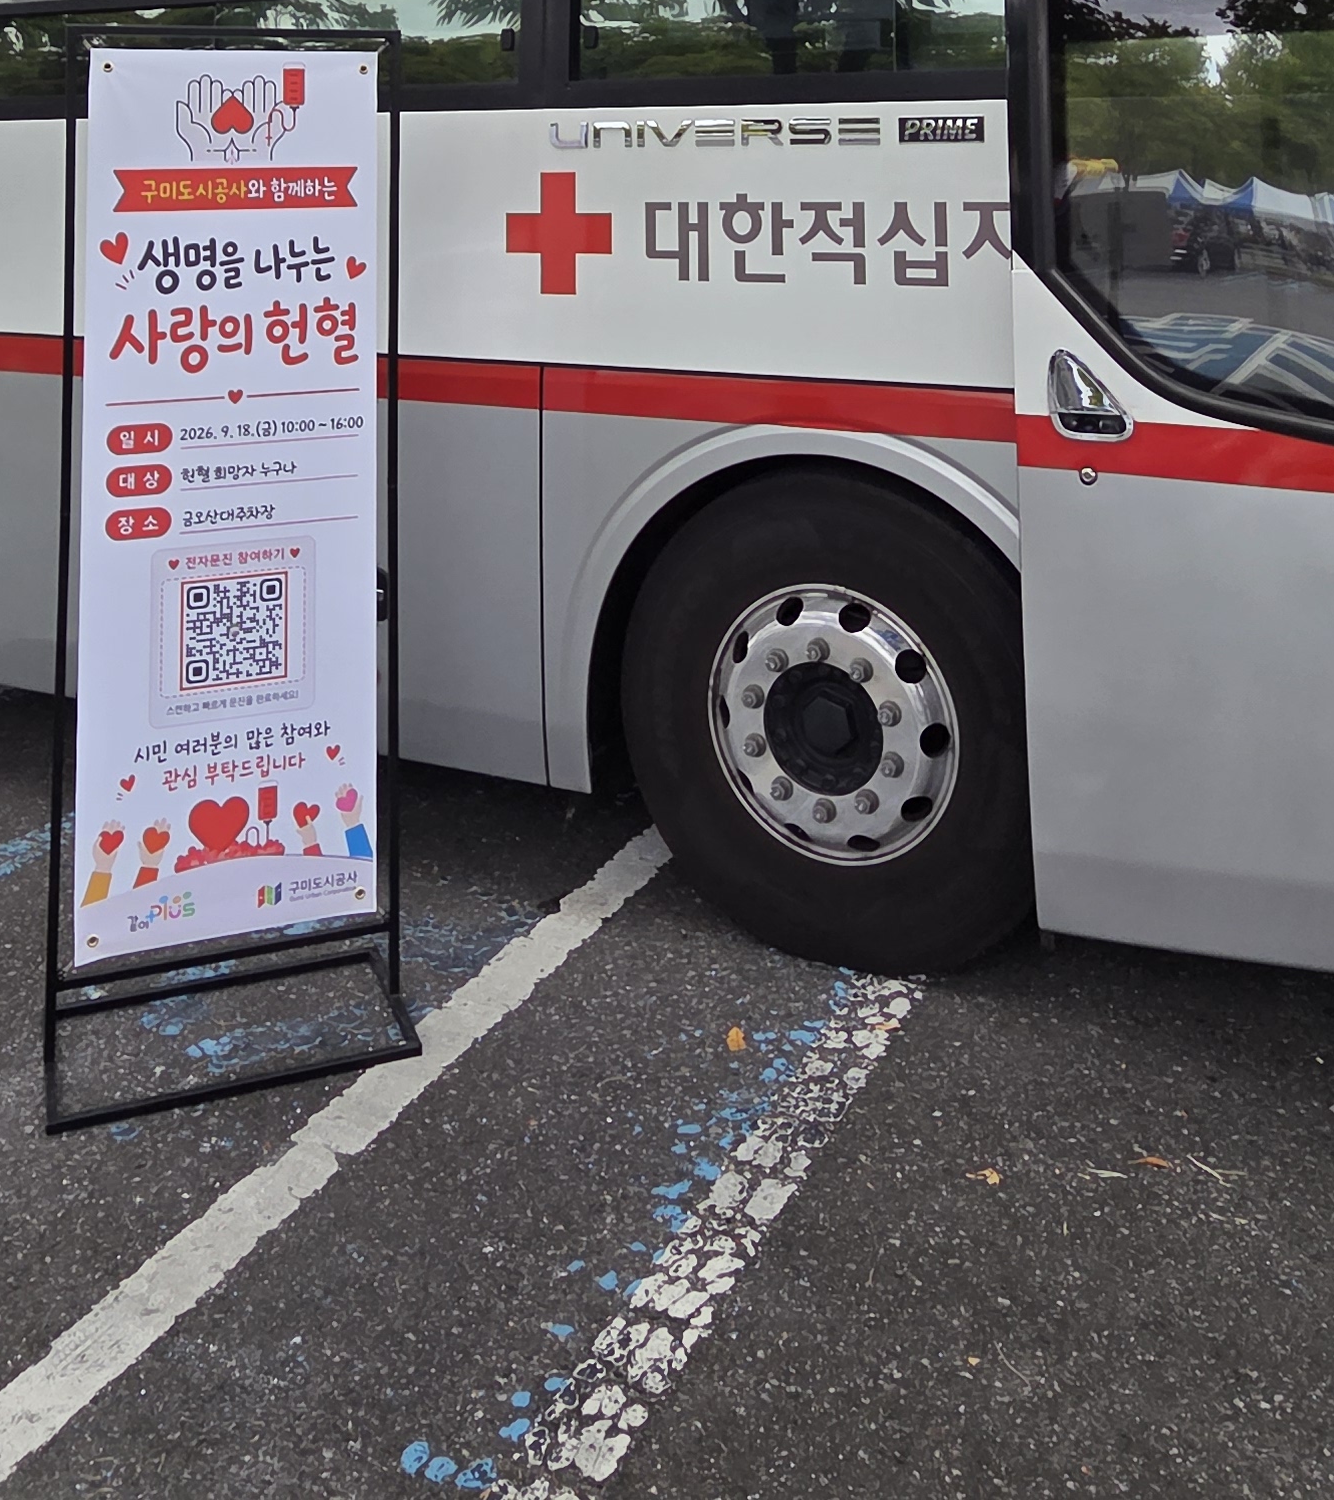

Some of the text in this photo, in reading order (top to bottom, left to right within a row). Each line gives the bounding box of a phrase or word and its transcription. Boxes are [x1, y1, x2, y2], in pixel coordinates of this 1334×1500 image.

[549, 116, 978, 149] UNIVERSE PRIME
[140, 177, 337, 203] 구미도시공사와 함께하는
[137, 236, 335, 294] 생명을 나누는
[109, 297, 359, 374] 사랑의 헌혈
[180, 427, 217, 441] 2026.
[181, 460, 297, 483] 헌혈 희망자 누구나
[182, 504, 275, 526] 금오산대주차장
[185, 547, 284, 569] 전자문진 참여하기
[133, 720, 330, 763] 시민 여러분의 많은 참여와
[162, 752, 305, 791] 관심 부탁드립니다
[288, 871, 358, 894] 구미도시공사
